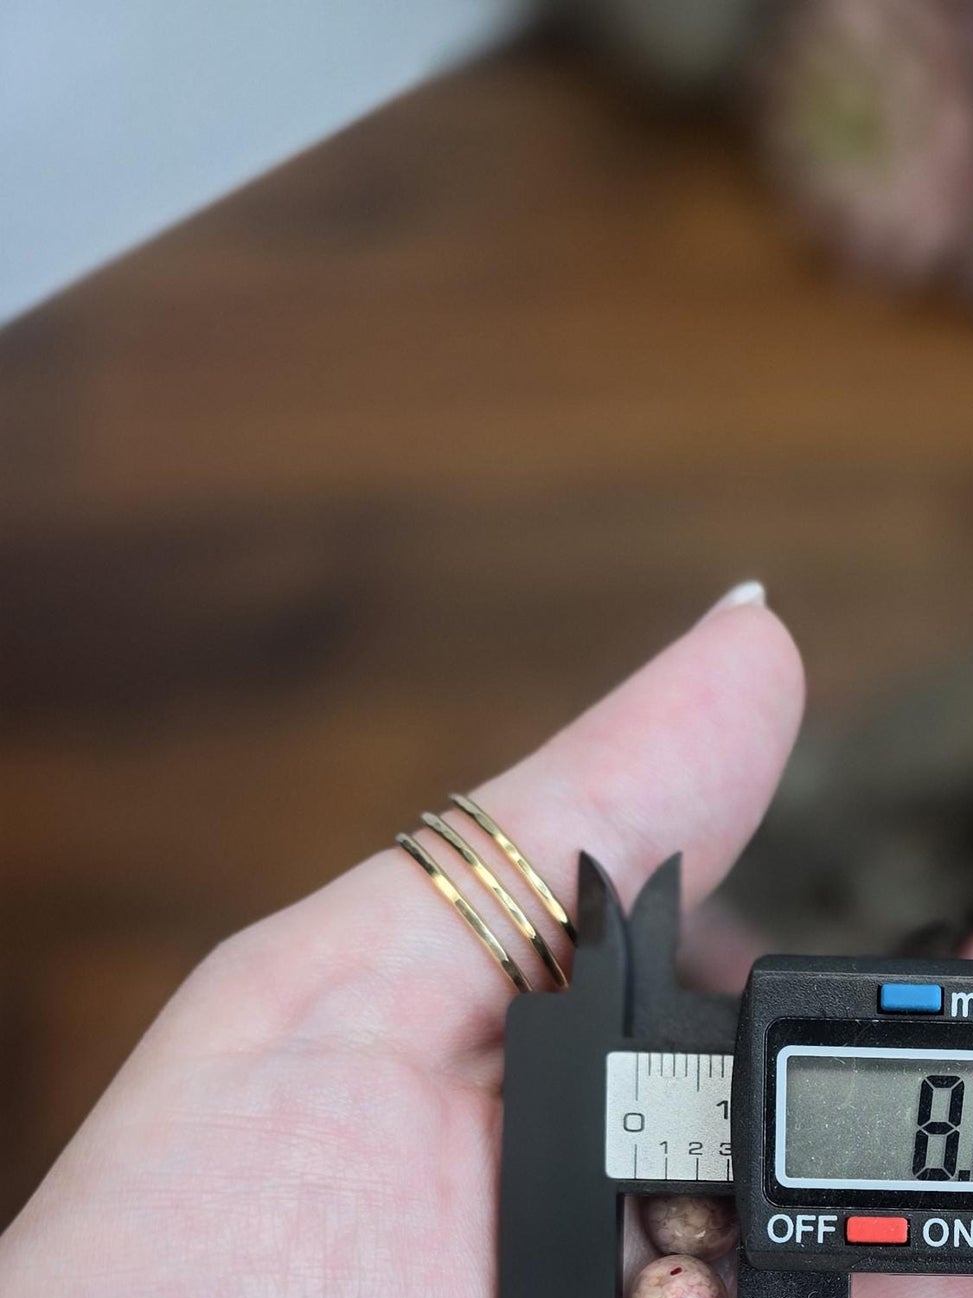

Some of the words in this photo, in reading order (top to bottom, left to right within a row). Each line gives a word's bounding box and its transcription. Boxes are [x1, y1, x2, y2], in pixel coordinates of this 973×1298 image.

[623, 1112, 645, 1132] 0
[716, 1100, 729, 1120] 1
[660, 1141, 668, 1154] 1
[688, 1141, 703, 1155] 2
[719, 1142, 731, 1156] 3
[767, 1214, 838, 1244] OFF
